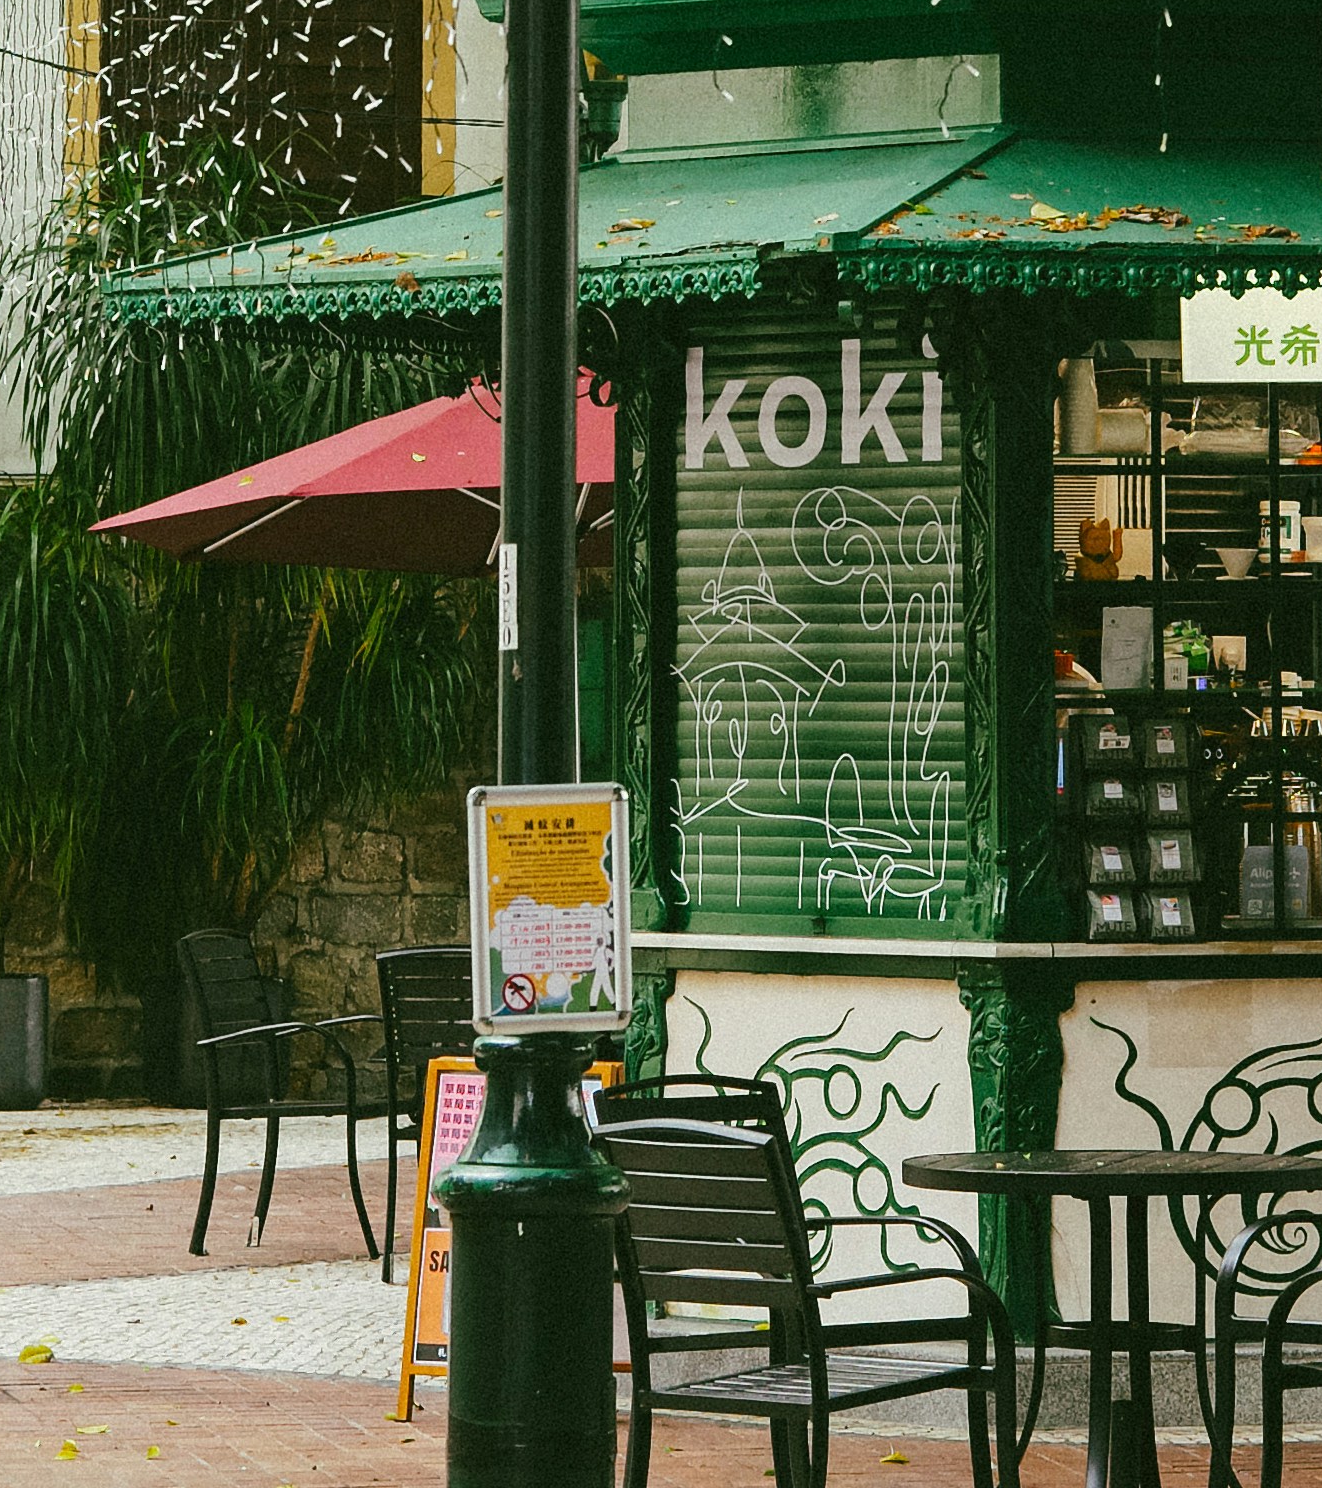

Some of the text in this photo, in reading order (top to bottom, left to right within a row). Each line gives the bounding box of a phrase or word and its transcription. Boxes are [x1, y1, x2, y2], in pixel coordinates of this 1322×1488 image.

[685, 333, 942, 469] koki
[1096, 921, 1134, 932] MUTE
[1154, 926, 1190, 936] MUTE
